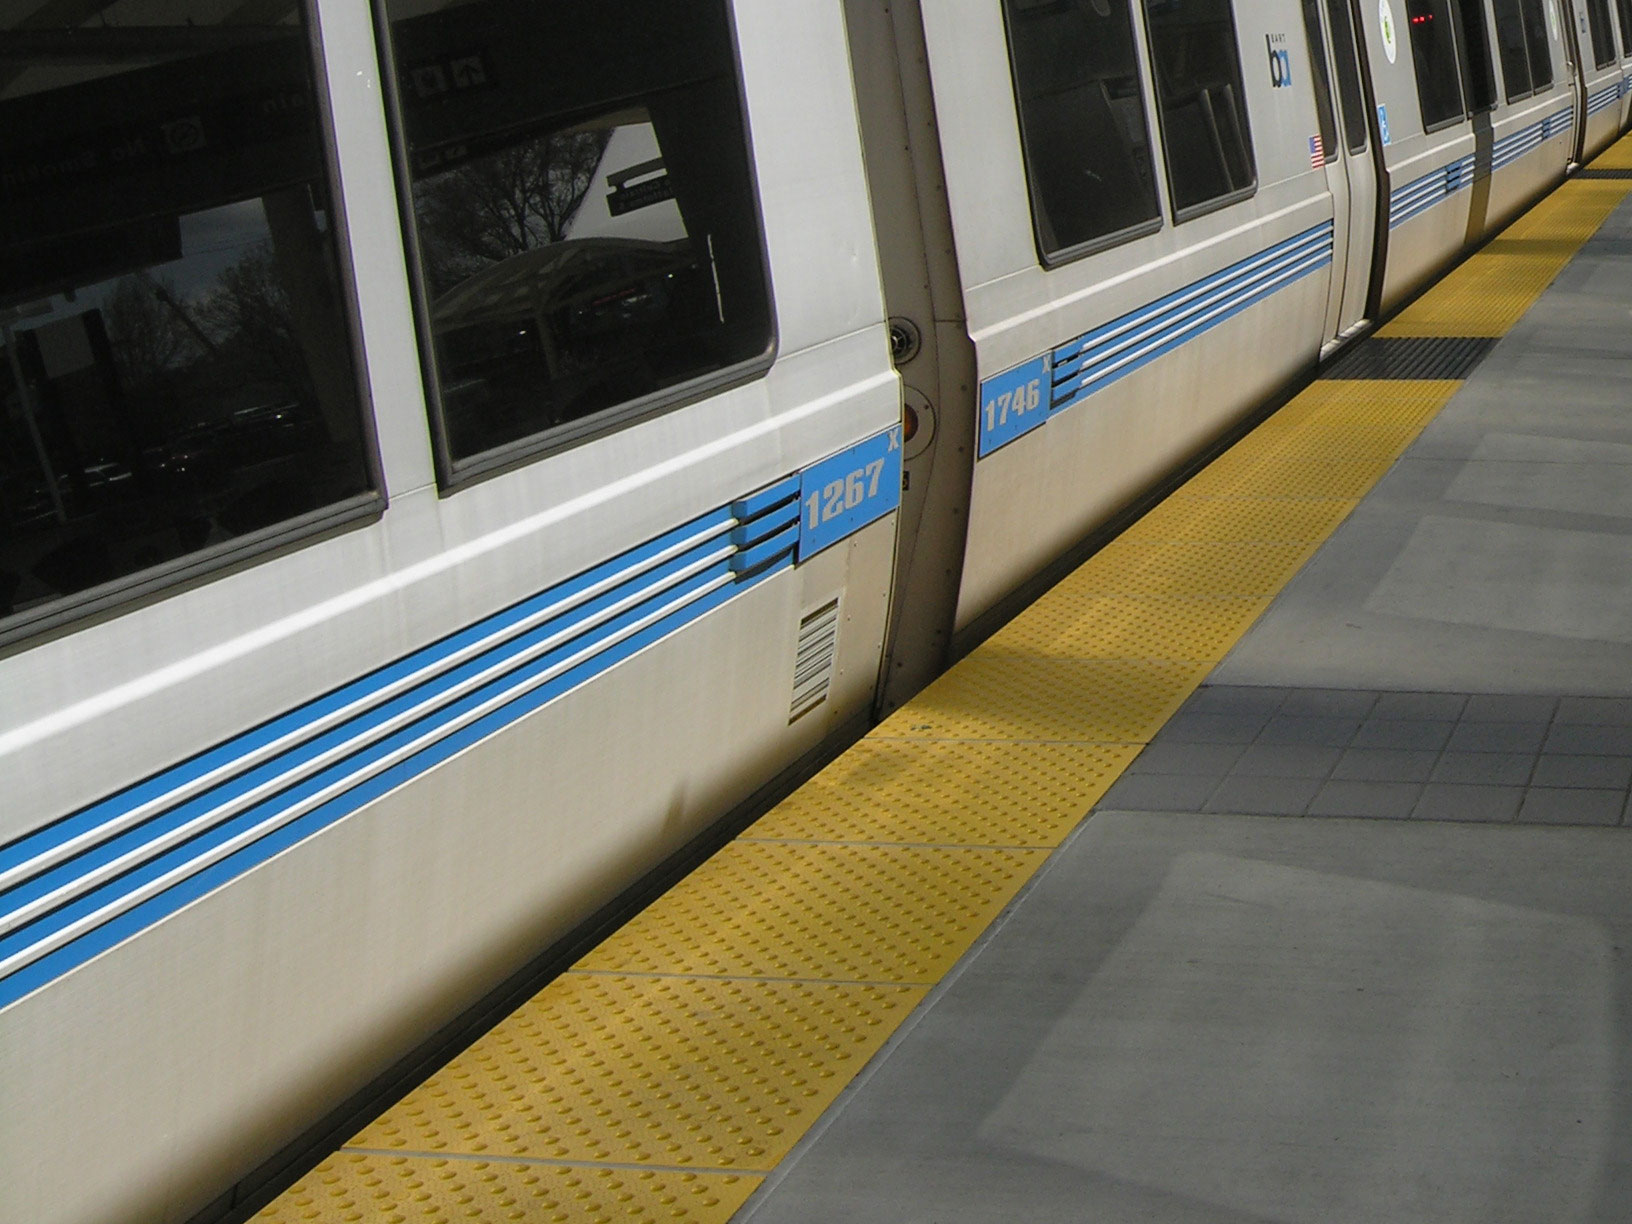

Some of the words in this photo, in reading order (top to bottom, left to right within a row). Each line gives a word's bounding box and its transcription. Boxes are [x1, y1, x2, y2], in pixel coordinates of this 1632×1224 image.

[985, 378, 1040, 432] 1746
[805, 457, 885, 530] 1267
[888, 428, 899, 452] X
